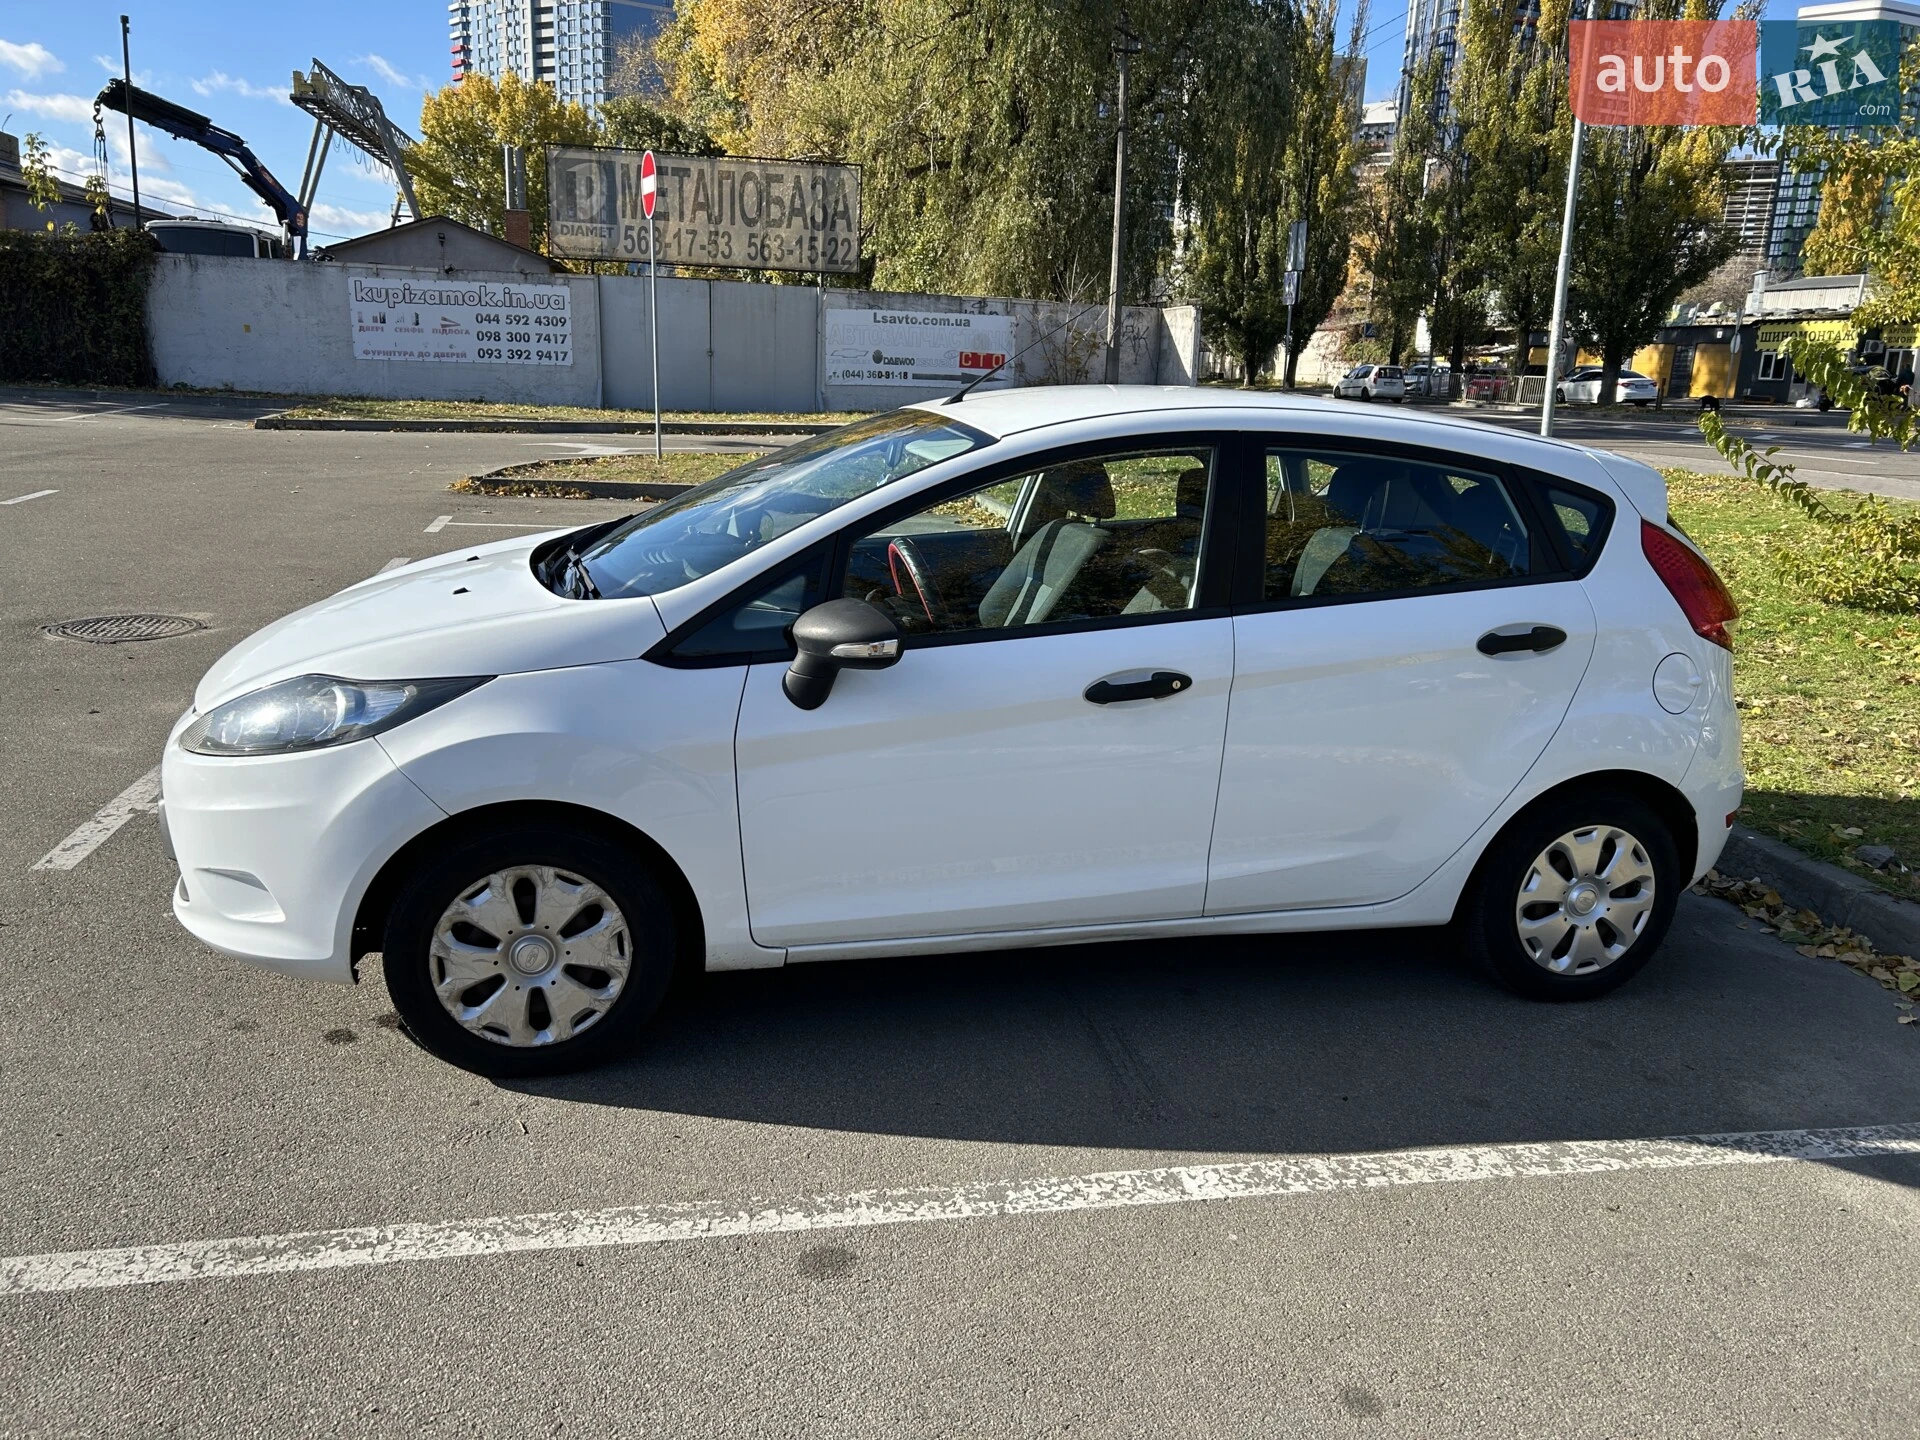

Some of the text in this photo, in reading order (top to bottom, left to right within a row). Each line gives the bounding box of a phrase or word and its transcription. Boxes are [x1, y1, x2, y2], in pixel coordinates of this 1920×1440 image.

[620, 163, 853, 233] МЕТАЛОБАЗА
[560, 224, 614, 239] DIAMET
[623, 225, 854, 266] 563-17-53 563-15-22
[354, 280, 565, 310] kupizamok.in.ua
[475, 313, 567, 328] 044 592 4309
[873, 312, 971, 328] Lsavto.com.ua
[432, 328, 470, 336] ПІДЛОГА
[476, 331, 568, 345] 098 300 7417
[1760, 330, 1856, 343] ШИНОМОНТАЖ
[417, 351, 431, 359] ДО
[477, 348, 569, 362] 093 392 9417
[883, 357, 915, 366] DAEWOO
[842, 369, 864, 380] (044)
[866, 370, 908, 380] 360-91-18
